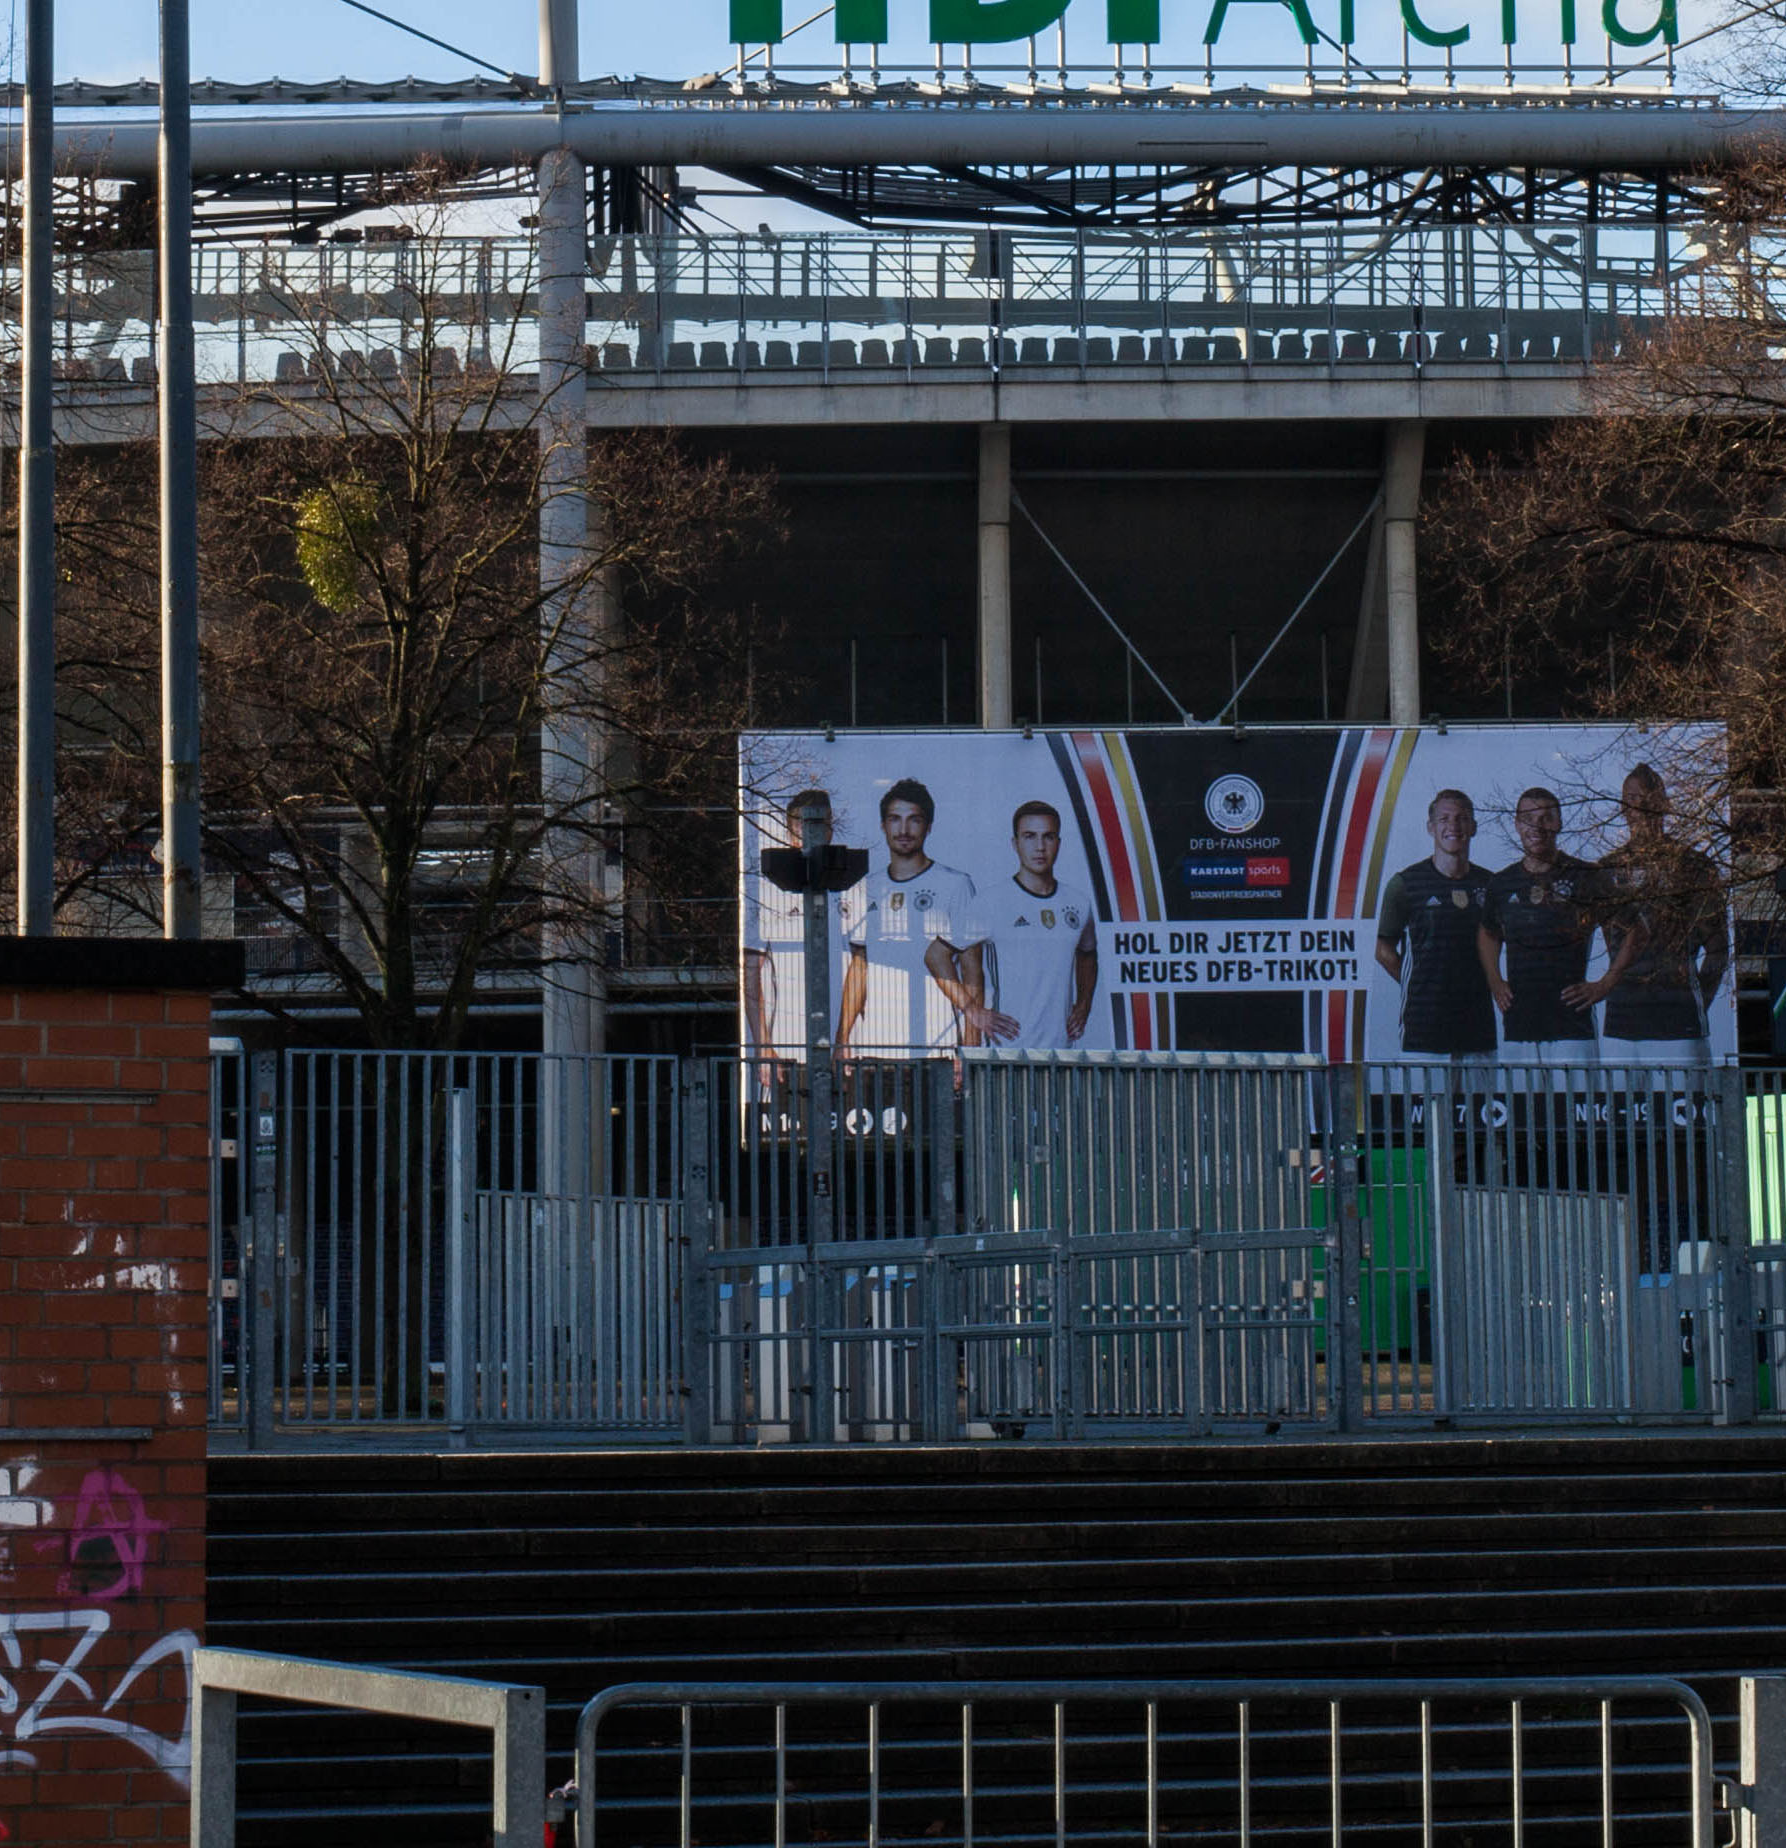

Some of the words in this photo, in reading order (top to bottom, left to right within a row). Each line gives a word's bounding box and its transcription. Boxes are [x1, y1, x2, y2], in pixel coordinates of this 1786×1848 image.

[1189, 837, 1281, 850] DFB-FANSHOP
[1190, 866, 1246, 876] KARSTADT
[1247, 864, 1282, 878] sports
[1114, 932, 1161, 954] HOL
[1169, 932, 1210, 954] DIR
[1217, 930, 1292, 954] JETZT
[1300, 929, 1356, 953] DEIN
[1120, 960, 1198, 983] NEUES
[1206, 958, 1359, 983] DFB-TRIKOT!
